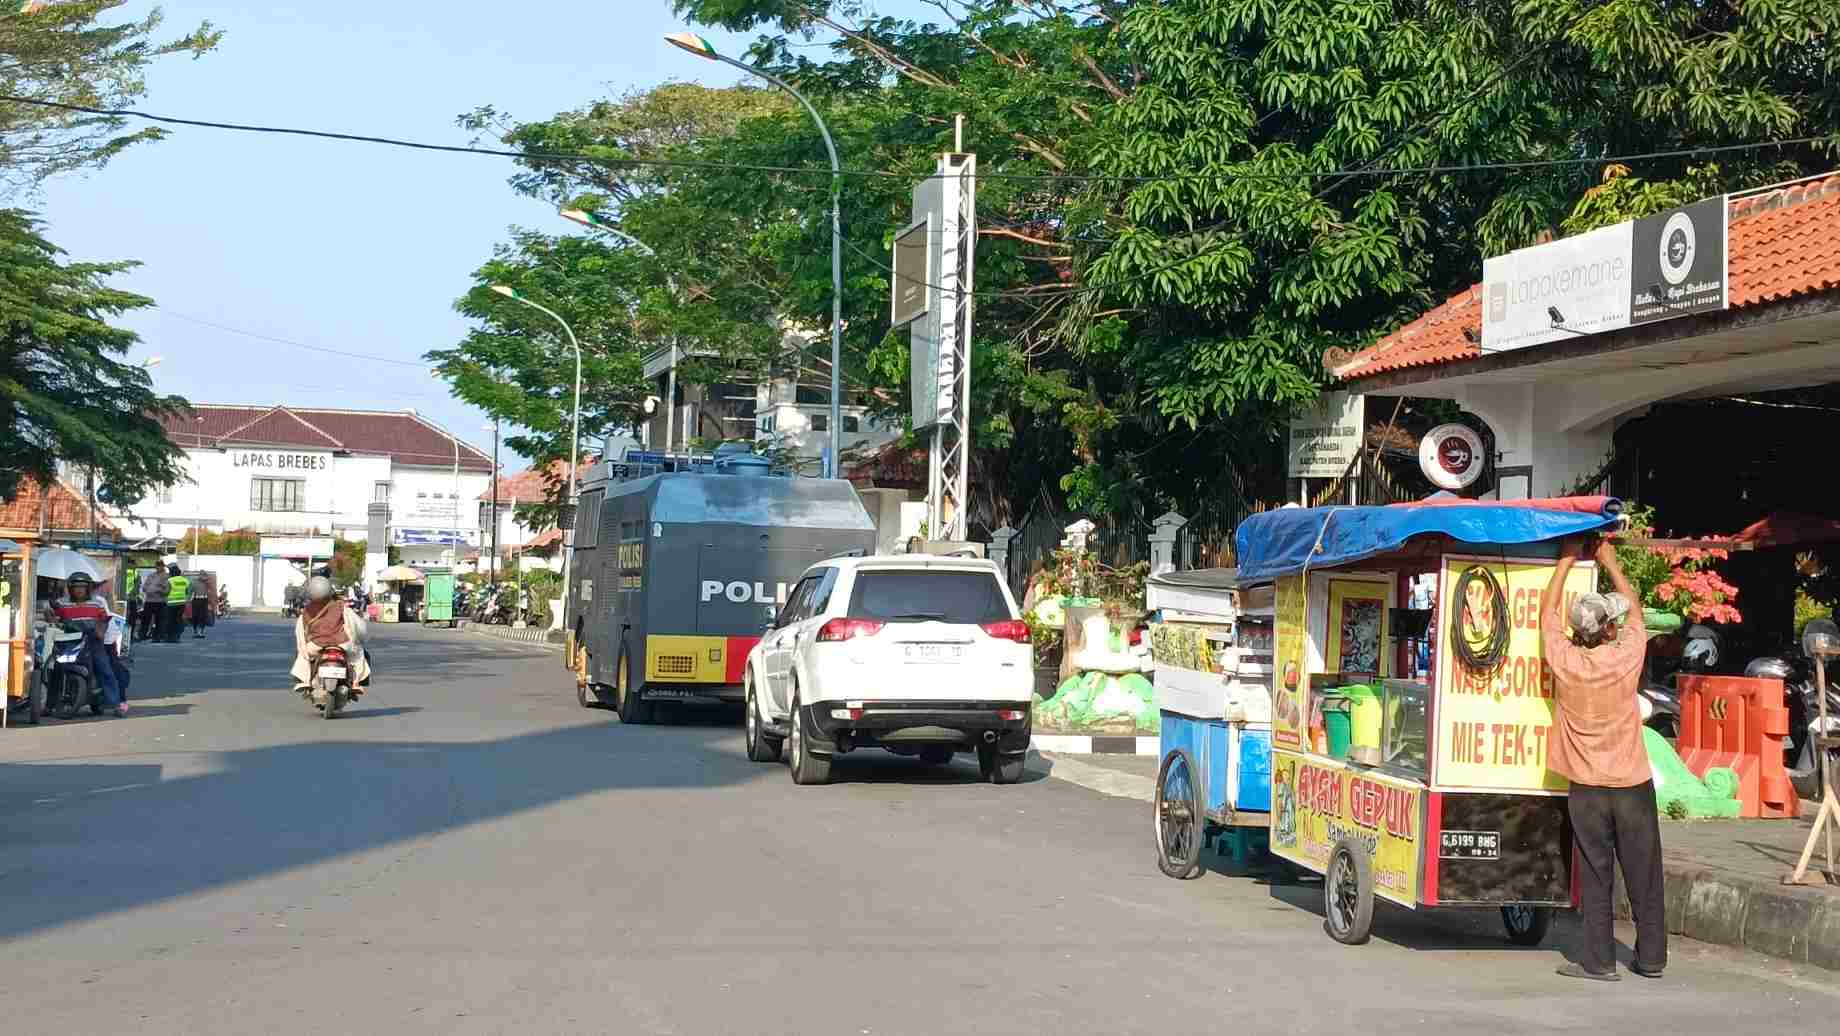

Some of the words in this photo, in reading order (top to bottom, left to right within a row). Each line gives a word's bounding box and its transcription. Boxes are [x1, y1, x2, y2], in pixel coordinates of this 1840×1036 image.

[233, 453, 273, 468] LAPAS
[278, 454, 326, 470] BREBES
[701, 580, 797, 604] POLI
[1500, 656, 1557, 699] GORE
[1451, 721, 1485, 764] MIE
[1491, 723, 1552, 767] TEK-T
[1297, 763, 1344, 818] AYAM
[1350, 776, 1415, 843] GEPUK
